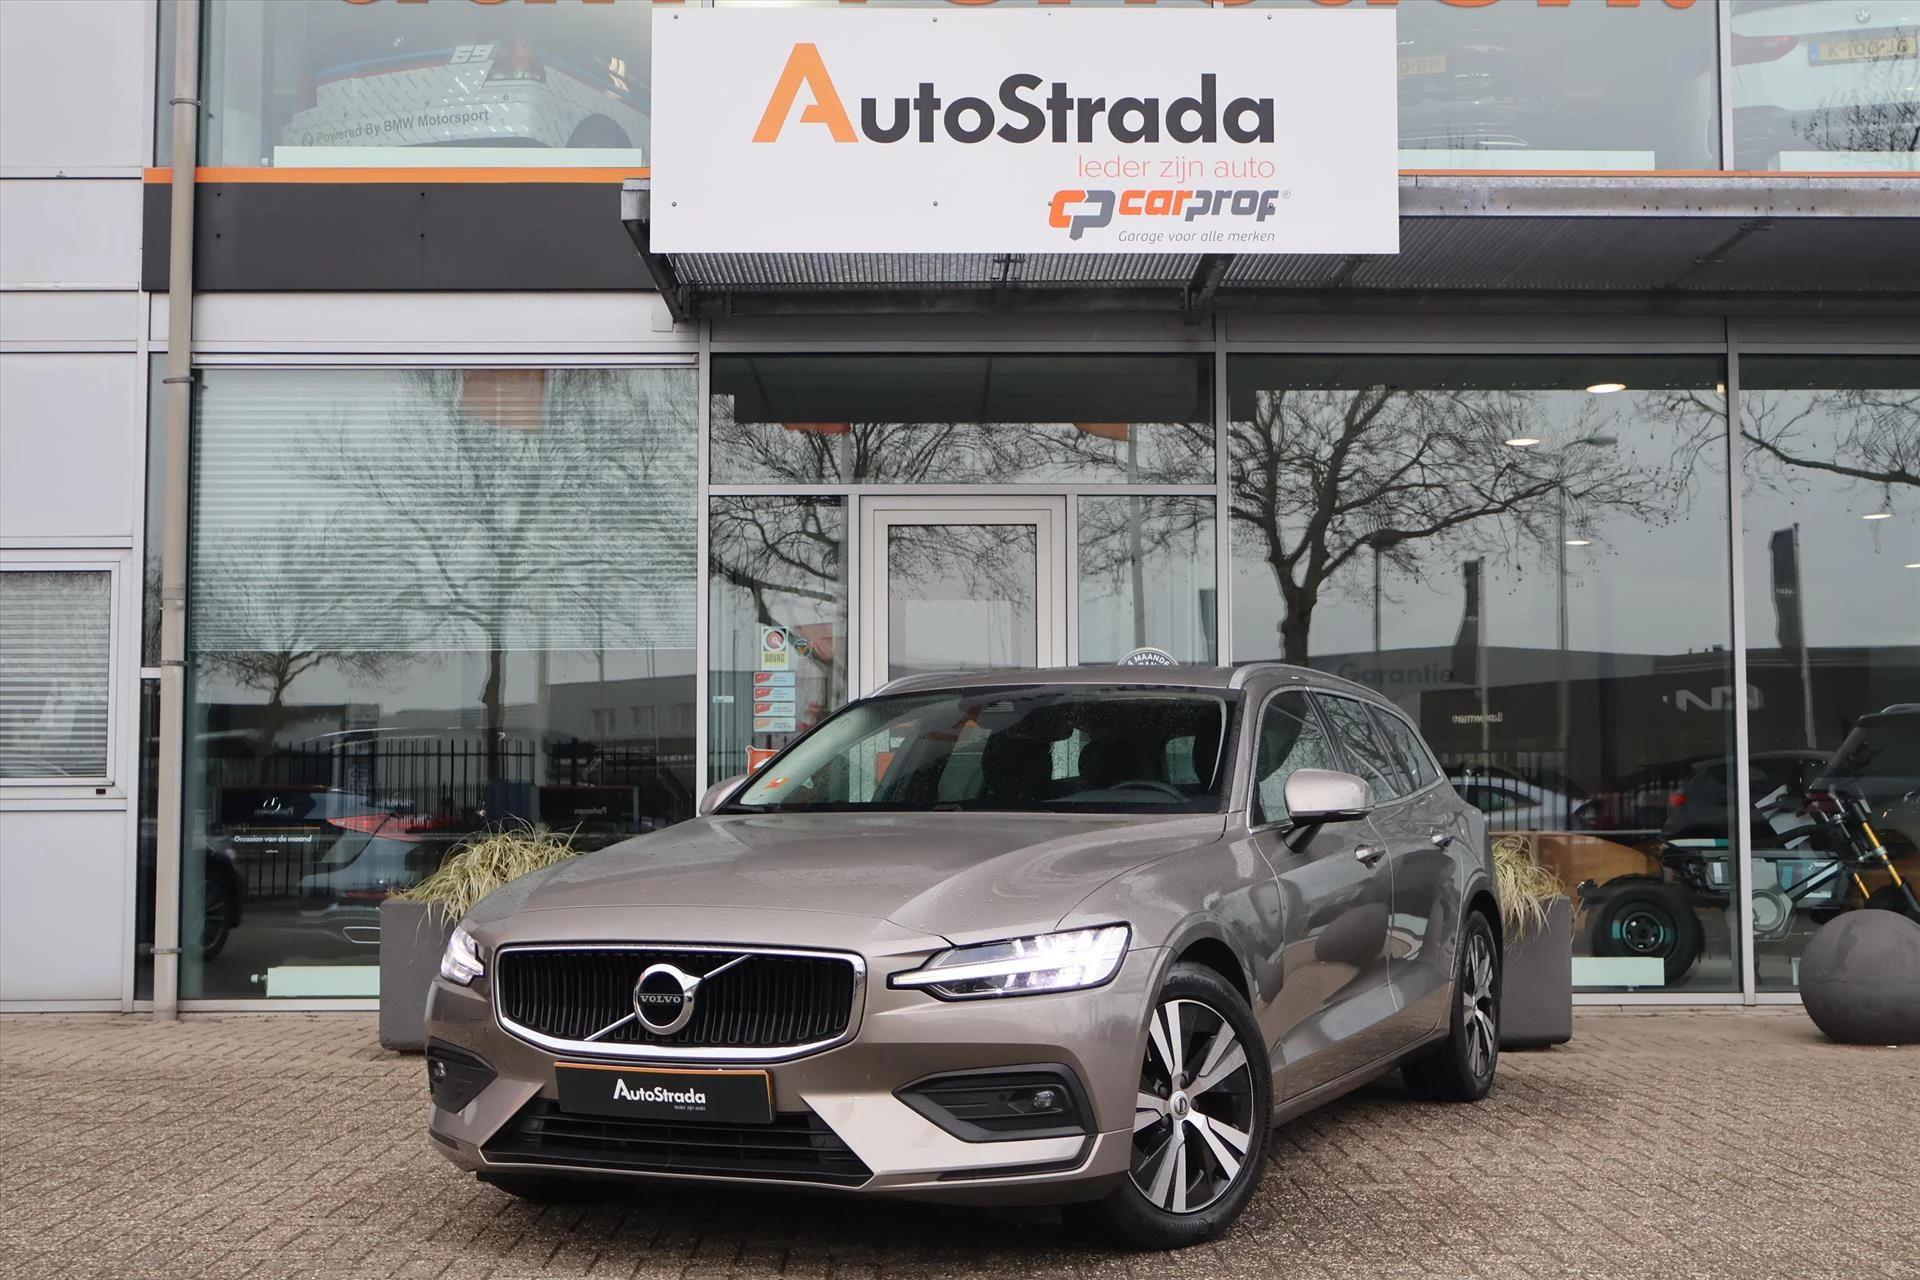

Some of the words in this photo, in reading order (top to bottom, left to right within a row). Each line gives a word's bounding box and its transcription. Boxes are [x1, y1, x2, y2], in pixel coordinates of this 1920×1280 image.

[451, 44, 494, 63] 69
[752, 43, 1274, 144] AutoStrada
[316, 126, 362, 143] Powered
[365, 122, 380, 137] By
[383, 117, 415, 133] BMW
[417, 109, 490, 128] Motorsport
[1160, 157, 1204, 184] zijn
[1214, 157, 1275, 178] auto
[1118, 230, 1164, 245] Garage
[1168, 232, 1197, 242] voor
[1200, 230, 1224, 242] alle
[1228, 230, 1275, 242] merken
[1338, 662, 1455, 684] Garantie
[233, 835, 263, 843] Occasion
[278, 835, 287, 843] de
[287, 835, 313, 843] maand
[640, 995, 681, 1004] VOLVO
[613, 1079, 706, 1104] AutoStrada
